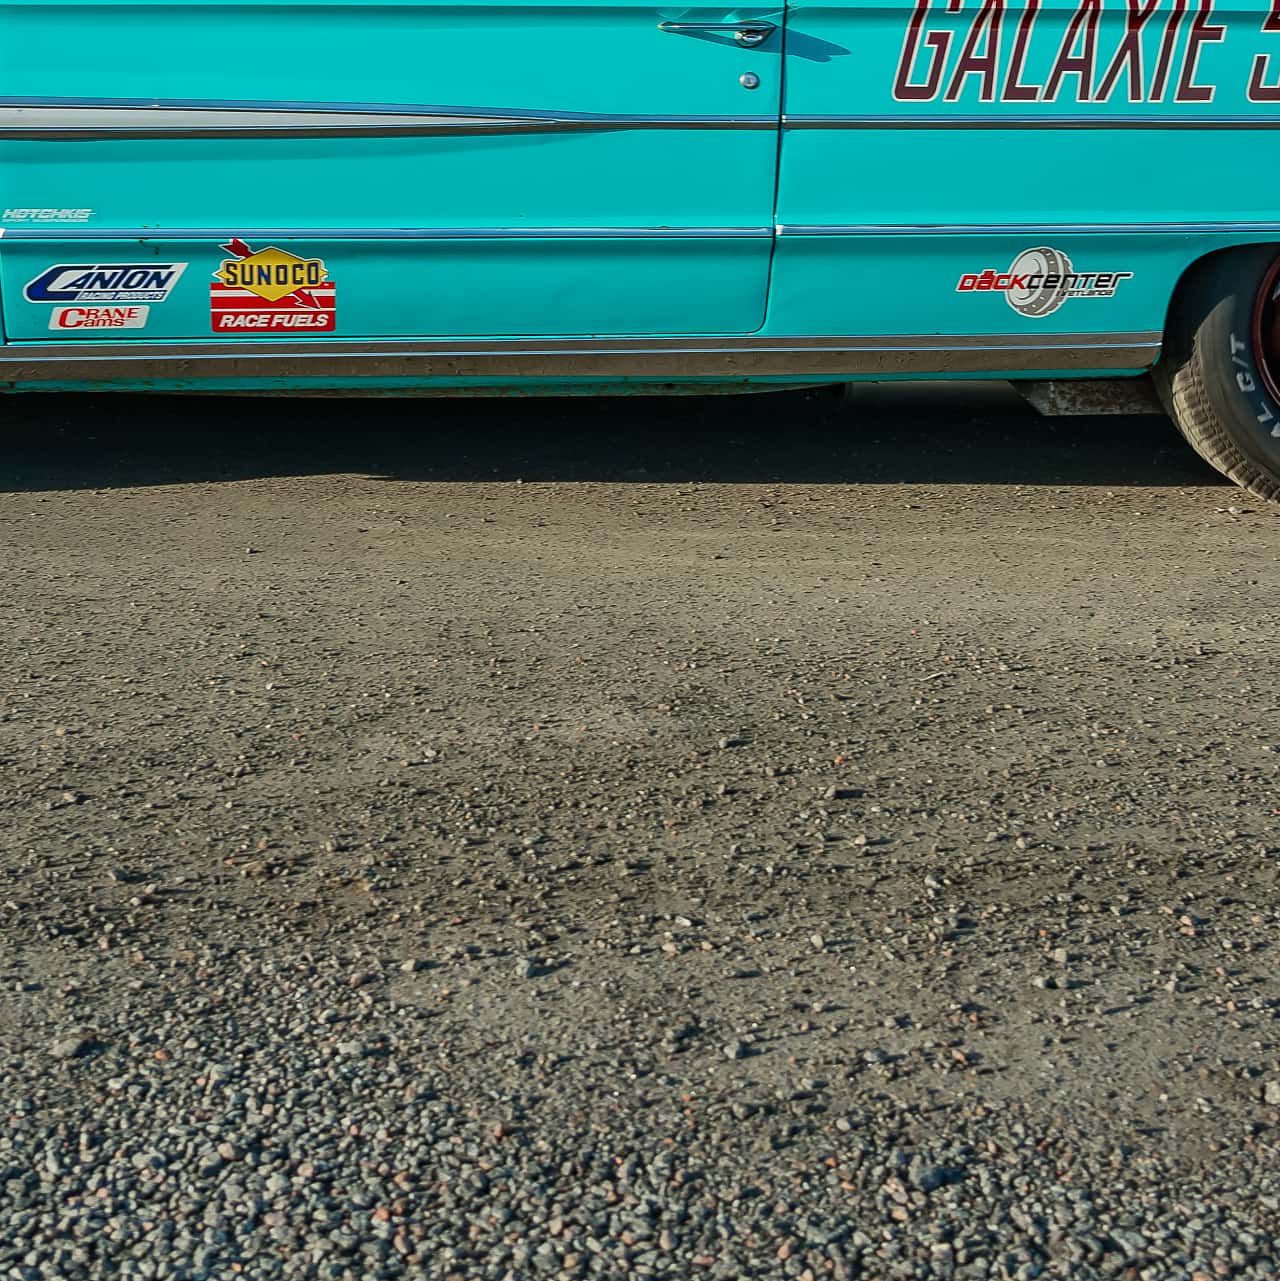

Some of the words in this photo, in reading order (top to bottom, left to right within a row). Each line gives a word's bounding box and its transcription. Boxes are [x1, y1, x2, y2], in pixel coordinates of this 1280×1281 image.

[26, 265, 176, 301] CANTON
[223, 261, 321, 287] SUNOCO
[219, 314, 269, 328] RACE
[272, 313, 329, 328] FUELS
